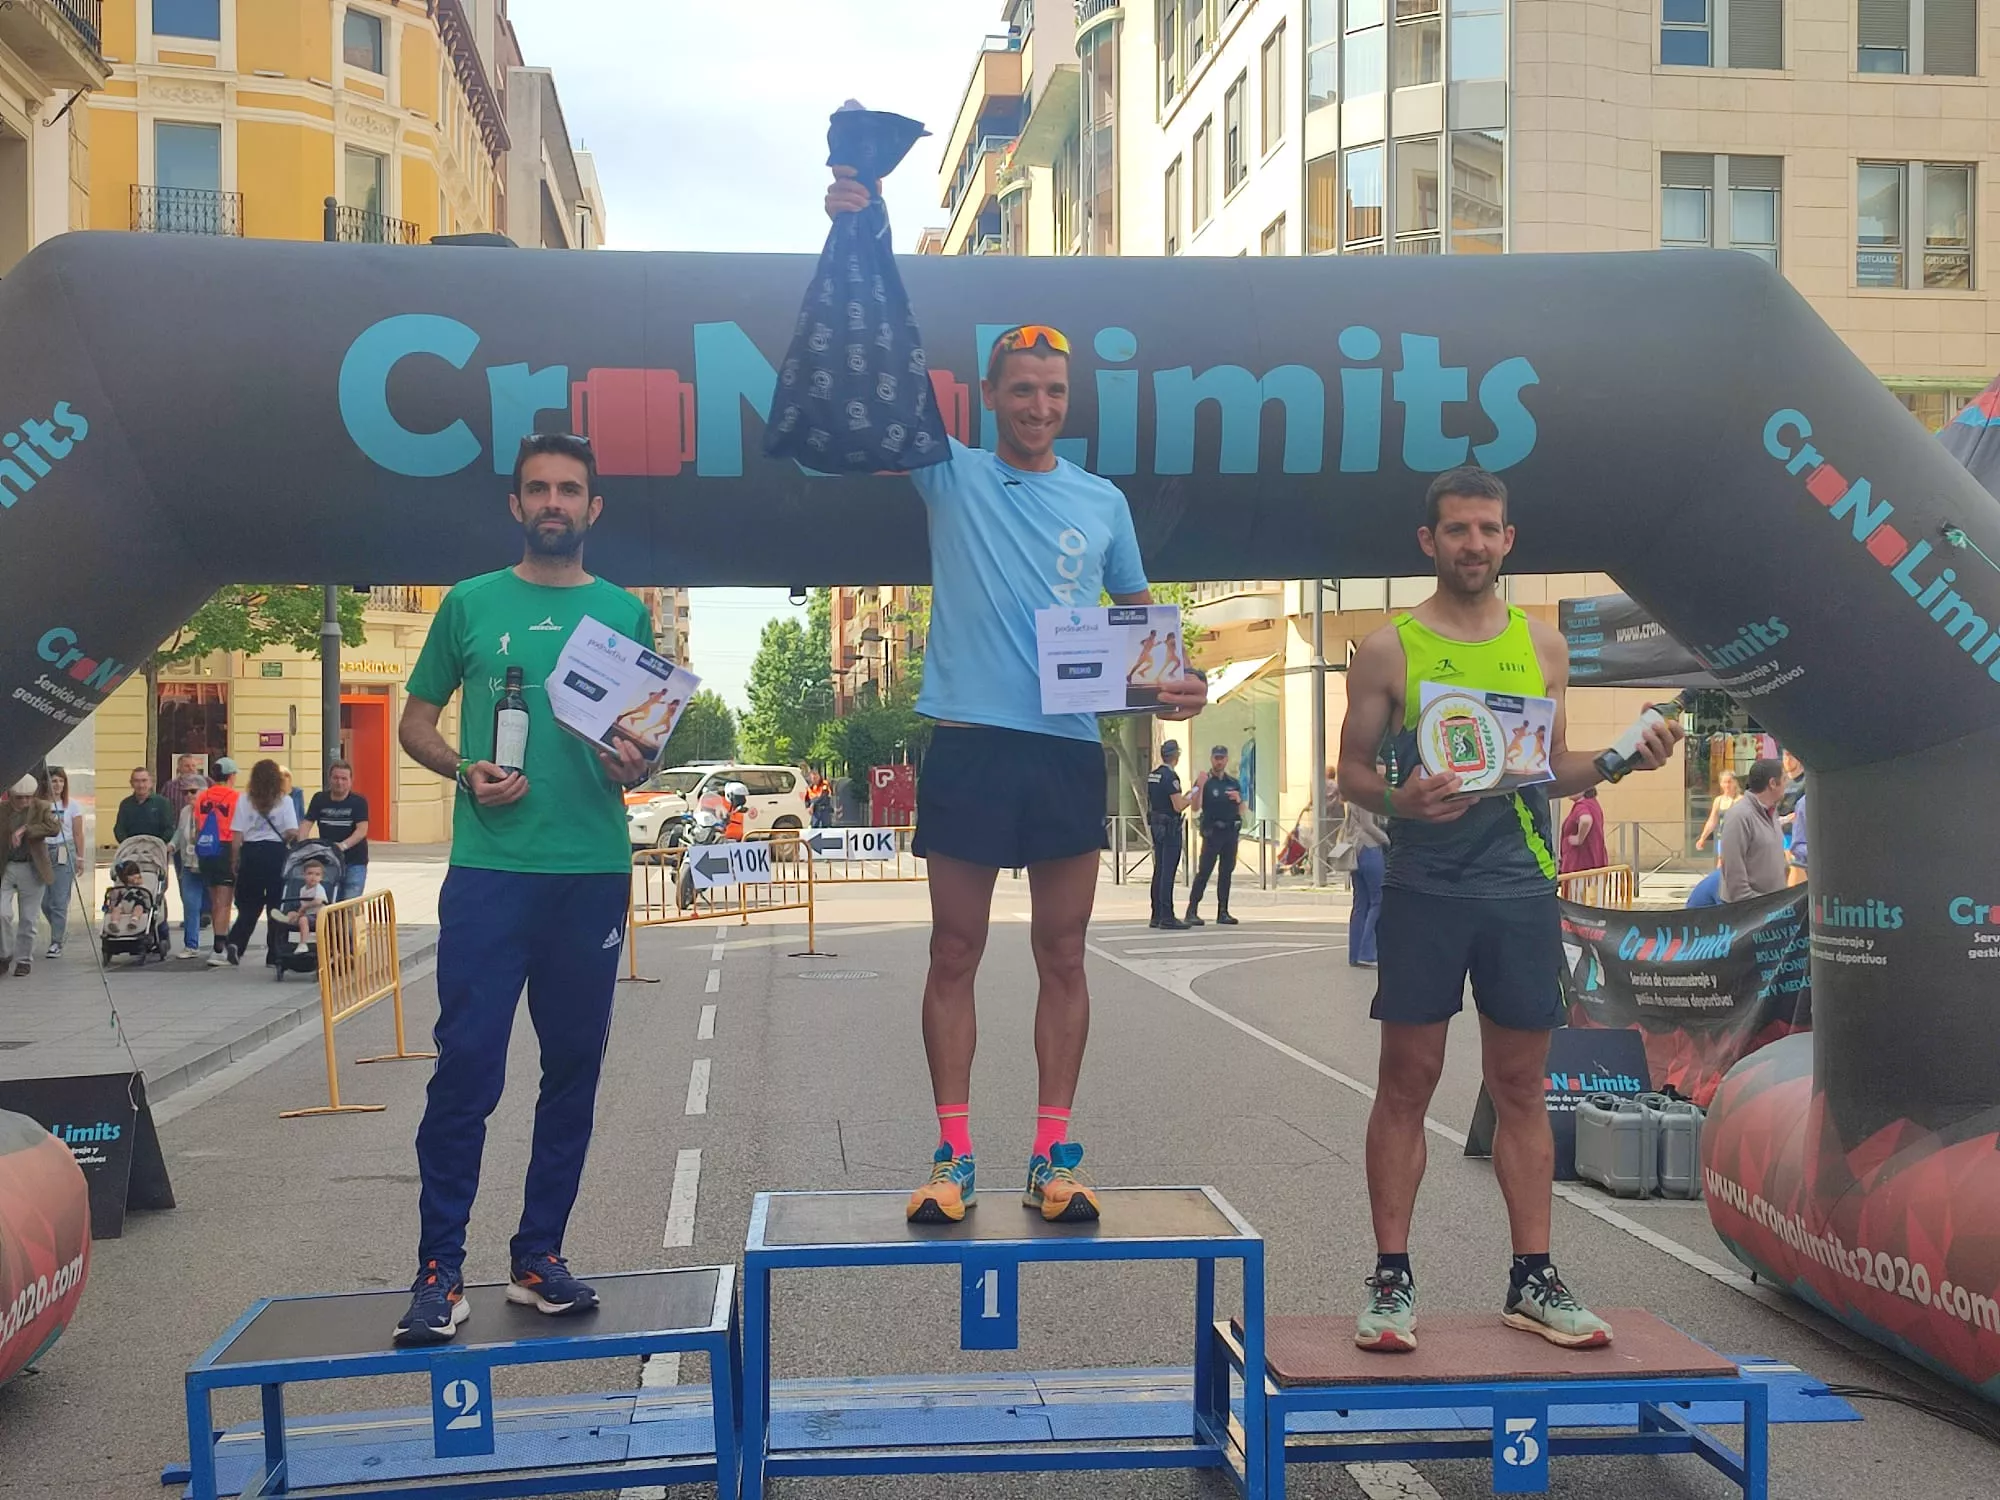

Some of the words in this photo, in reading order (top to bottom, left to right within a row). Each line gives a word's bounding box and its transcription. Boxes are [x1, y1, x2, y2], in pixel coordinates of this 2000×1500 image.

[733, 850, 770, 873] 10K
[850, 833, 893, 851] 10K
[976, 1269, 1001, 1319] 1
[442, 1379, 482, 1430] 2
[1503, 1418, 1540, 1467] 3
